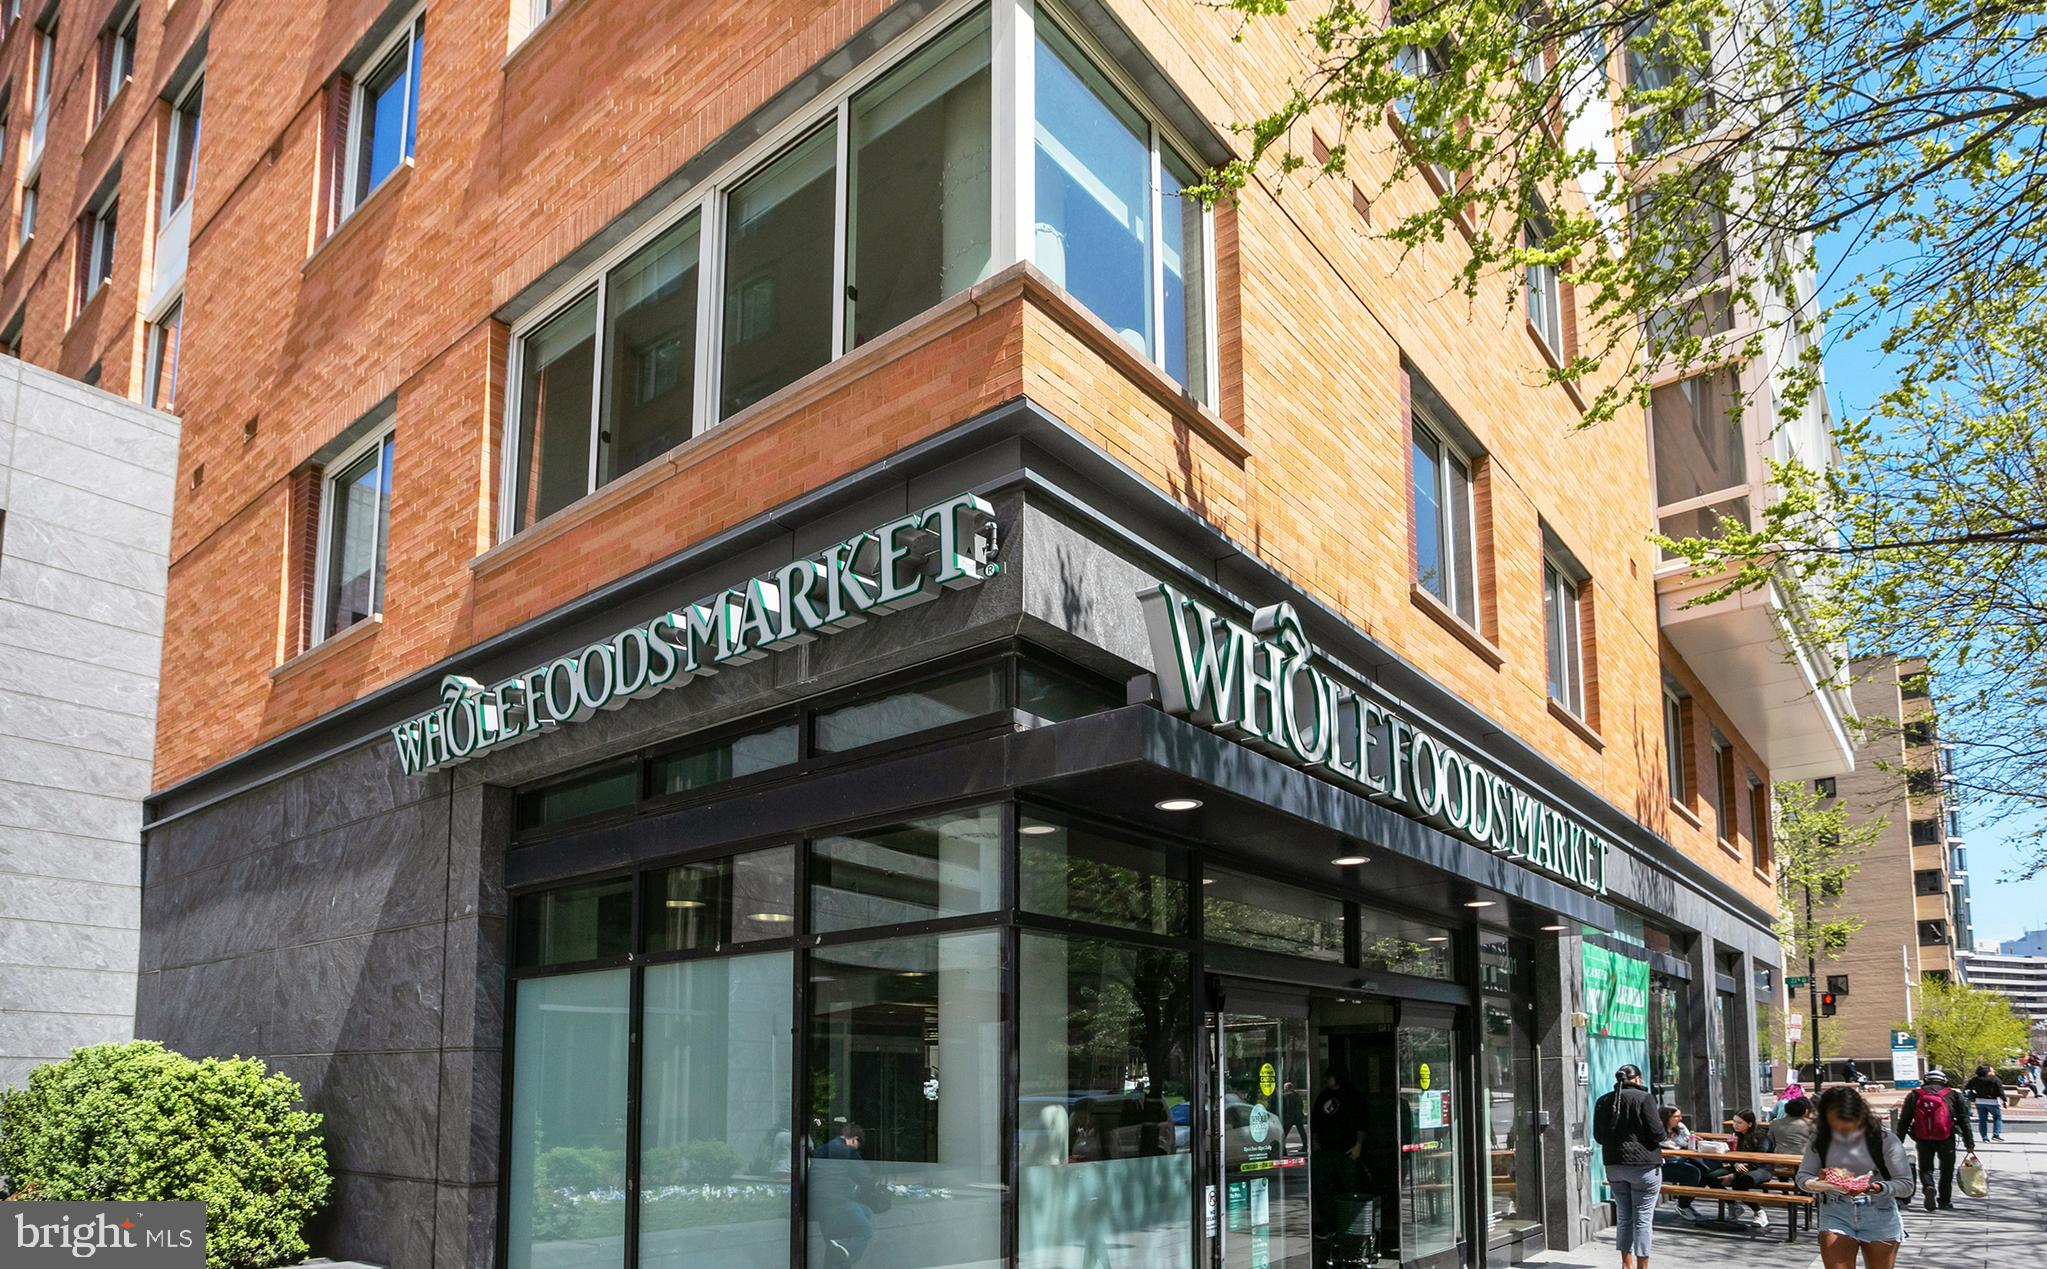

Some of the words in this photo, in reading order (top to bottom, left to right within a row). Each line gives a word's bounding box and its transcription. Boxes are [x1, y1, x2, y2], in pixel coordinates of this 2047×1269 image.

[390, 675, 525, 775] WHOLE
[522, 611, 679, 728] FOODS
[683, 492, 980, 672] MARKET
[1154, 581, 1387, 792] WHOLE
[1381, 711, 1508, 852] FOODS
[1507, 787, 1610, 896] MARKET
[1897, 1031, 1909, 1045] P
